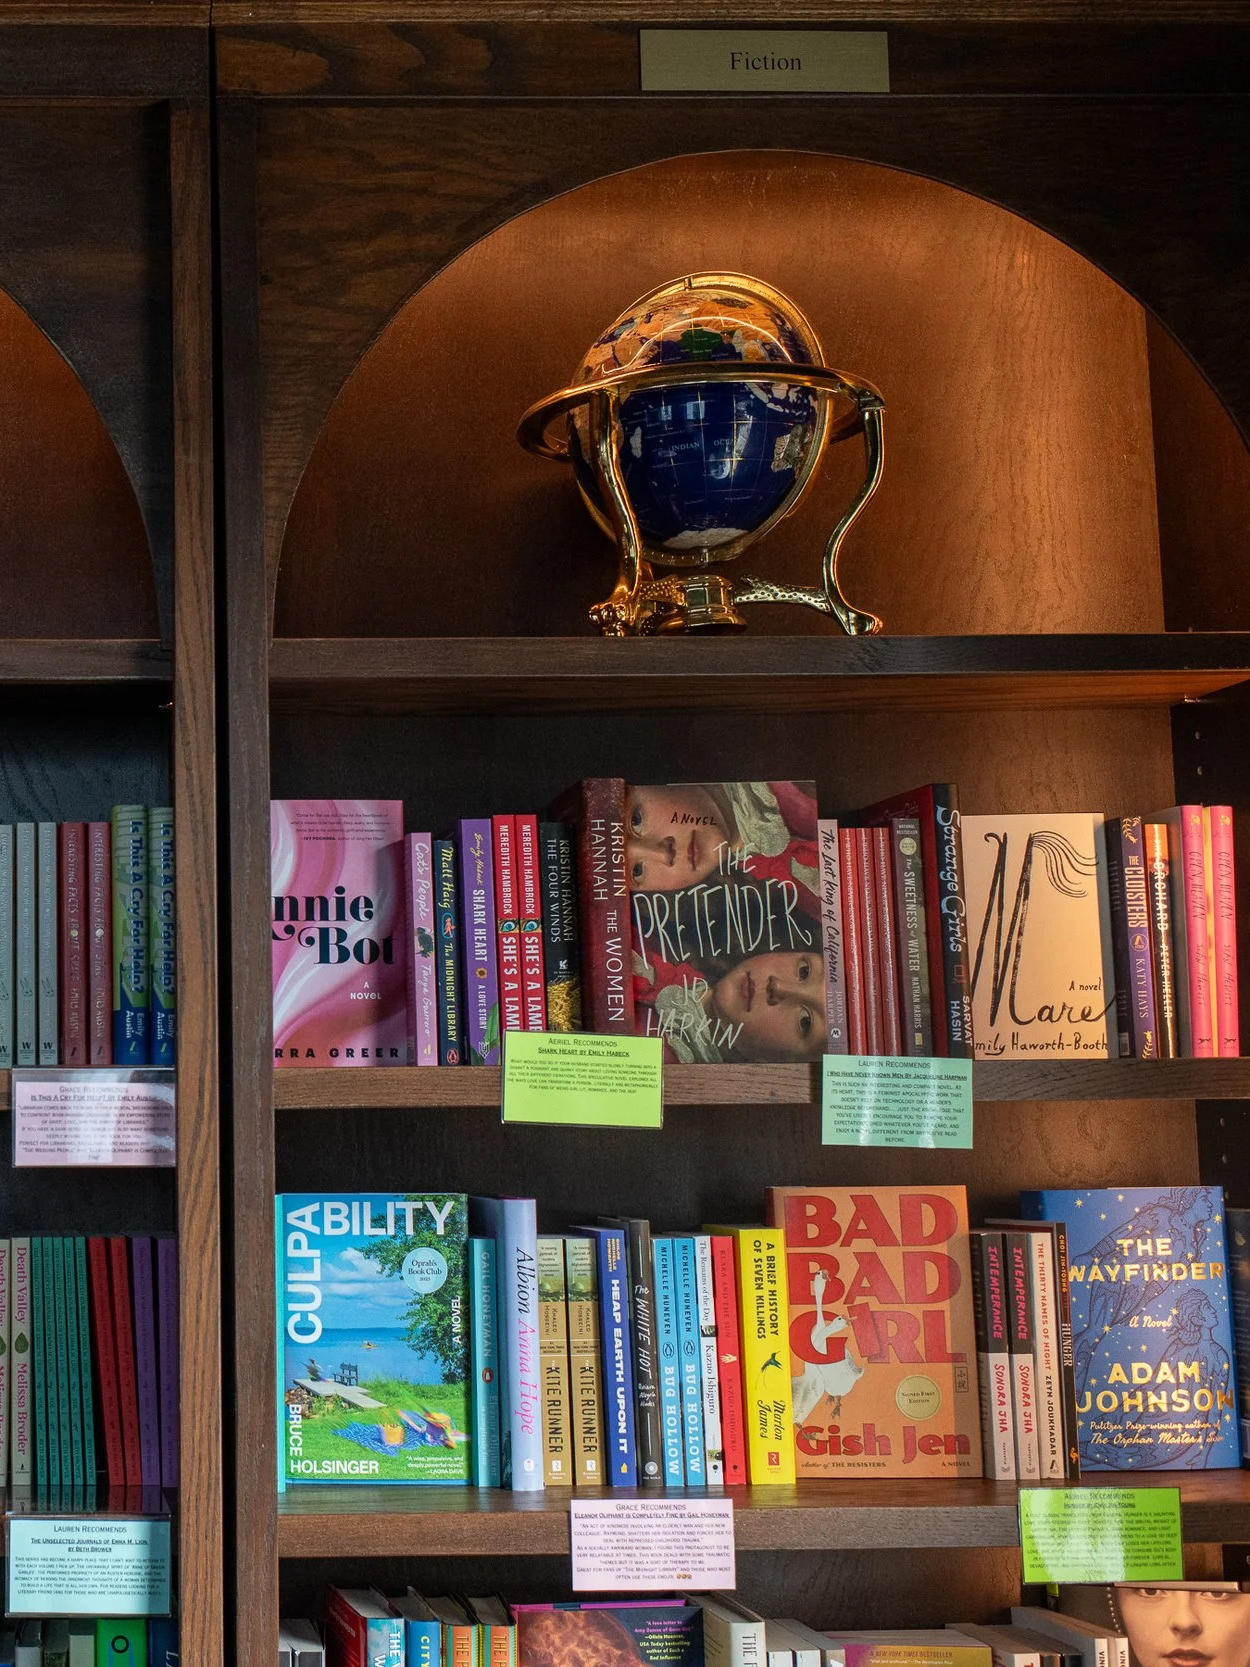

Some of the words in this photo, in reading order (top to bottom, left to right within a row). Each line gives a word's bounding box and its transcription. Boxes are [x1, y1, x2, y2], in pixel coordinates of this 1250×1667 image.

[730, 52, 802, 70] Fiction
[499, 825, 510, 867] MEREDITH
[590, 819, 608, 900] HANNAH
[610, 822, 626, 897] KRISTIN
[714, 841, 756, 876] THE
[936, 804, 960, 893] Strange
[473, 889, 486, 925] SHARK
[501, 870, 512, 914] HAMBROCK
[606, 910, 618, 933] THE
[633, 879, 812, 970] PRETENDER
[941, 896, 965, 953] Girls
[474, 929, 487, 963] HEART
[606, 938, 624, 1022] WOMEN
[646, 1008, 744, 1049] HARKIN
[950, 1000, 962, 1042] HASIN
[962, 996, 973, 1046] SARVAT
[329, 1048, 399, 1058] GREER
[784, 1194, 958, 1247] BAD
[753, 1240, 761, 1253] OF
[1117, 1239, 1173, 1256] THE
[287, 1200, 454, 1344] CULPABILITY
[517, 1247, 535, 1314] Albion
[754, 1257, 764, 1292] SEVEN
[766, 1253, 776, 1285] BRIEF
[789, 1251, 962, 1305] BAD
[1069, 1262, 1224, 1281] WAYFINDER
[612, 1280, 620, 1322] HEAP
[768, 1290, 778, 1336] HISTORY
[988, 1246, 1003, 1340] INTEMPERANCE
[756, 1295, 766, 1339] KILLINGS
[791, 1304, 967, 1365] GIRL
[517, 1321, 536, 1373] Anna
[613, 1327, 623, 1382] EARTH
[546, 1366, 560, 1396] KITE
[685, 1364, 696, 1395] BUG
[1108, 1361, 1200, 1383] ADAM
[514, 1380, 538, 1434] Hope
[616, 1387, 626, 1434] UPON
[757, 1400, 770, 1438] James
[772, 1400, 786, 1441] Marlon
[1076, 1388, 1234, 1414] JOHNSON
[289, 1404, 302, 1457] BRUCE
[547, 1399, 563, 1453] RUNNER
[618, 1438, 627, 1453] IT
[688, 1402, 701, 1473] HOLLOW
[796, 1423, 892, 1458] Gish
[903, 1425, 970, 1465] Jen
[290, 1460, 379, 1475] HOLSINGER
